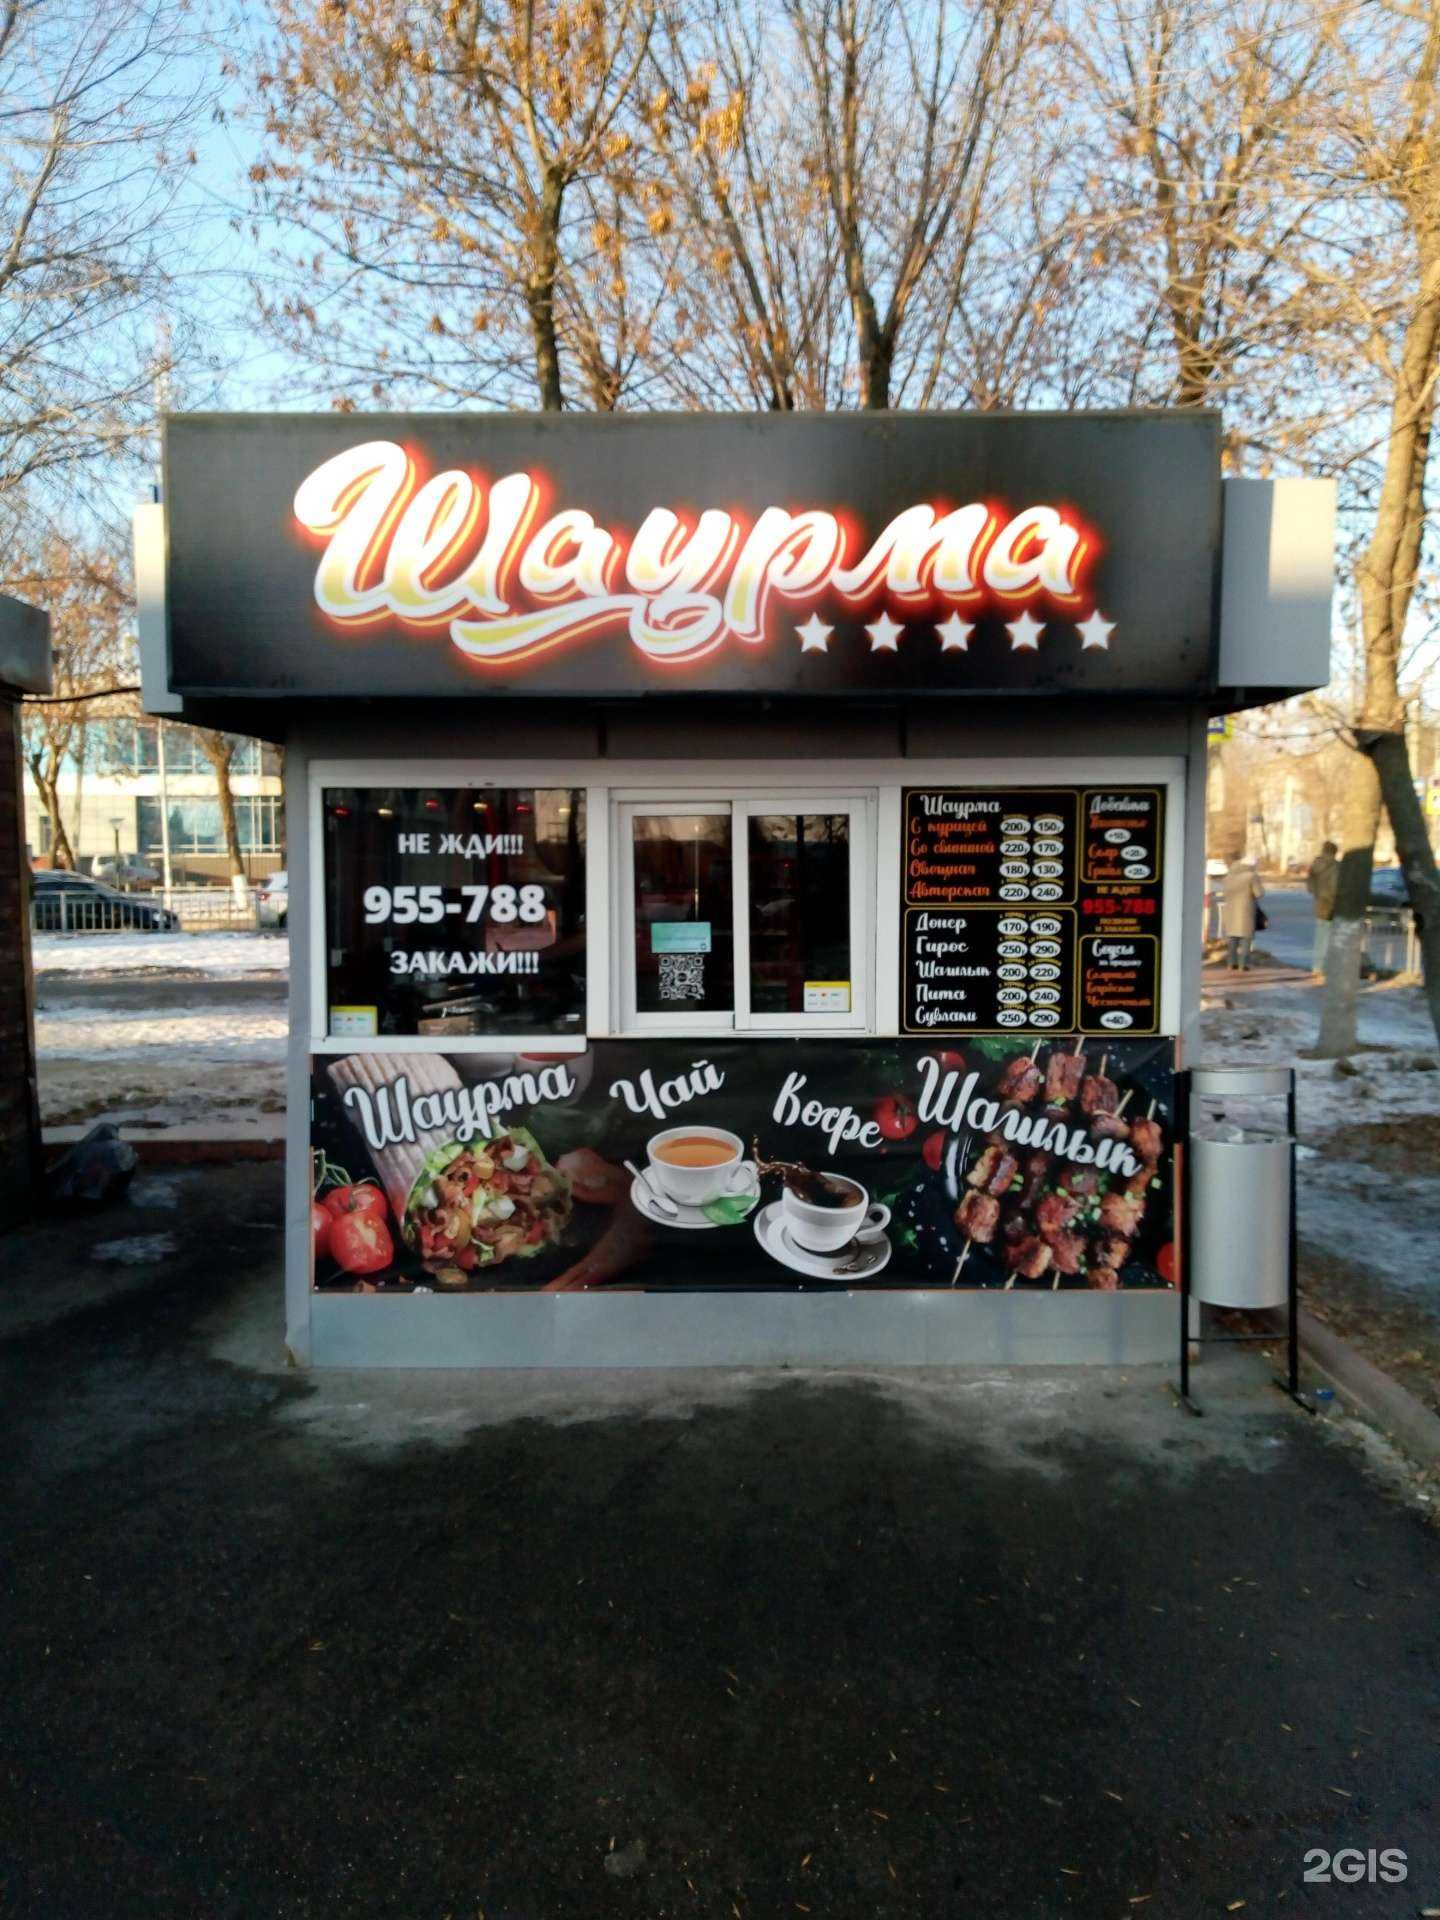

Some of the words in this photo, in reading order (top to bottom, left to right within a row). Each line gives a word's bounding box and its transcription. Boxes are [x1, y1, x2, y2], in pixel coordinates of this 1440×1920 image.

[293, 440, 1090, 668] Шаурма
[920, 794, 1001, 819] Шаурма
[911, 816, 921, 834] С
[927, 820, 988, 838] курицей
[399, 833, 430, 854] НЕ
[438, 833, 524, 860] ЖДИ!!!
[911, 838, 928, 856] Со
[910, 881, 990, 901] Авторская
[363, 884, 547, 924] 955-788
[915, 912, 968, 934] Донер
[915, 936, 969, 958] Гирос
[389, 950, 540, 974] ЗАКАЖИ!!!
[915, 960, 991, 978] Шашлык
[915, 983, 967, 1002] Пита
[915, 1006, 978, 1027] Сувлаки
[609, 1060, 726, 1119] Чай
[344, 1063, 575, 1150] Шаурма
[772, 1071, 884, 1156] Кофе
[916, 1055, 1143, 1178] Шашлык
